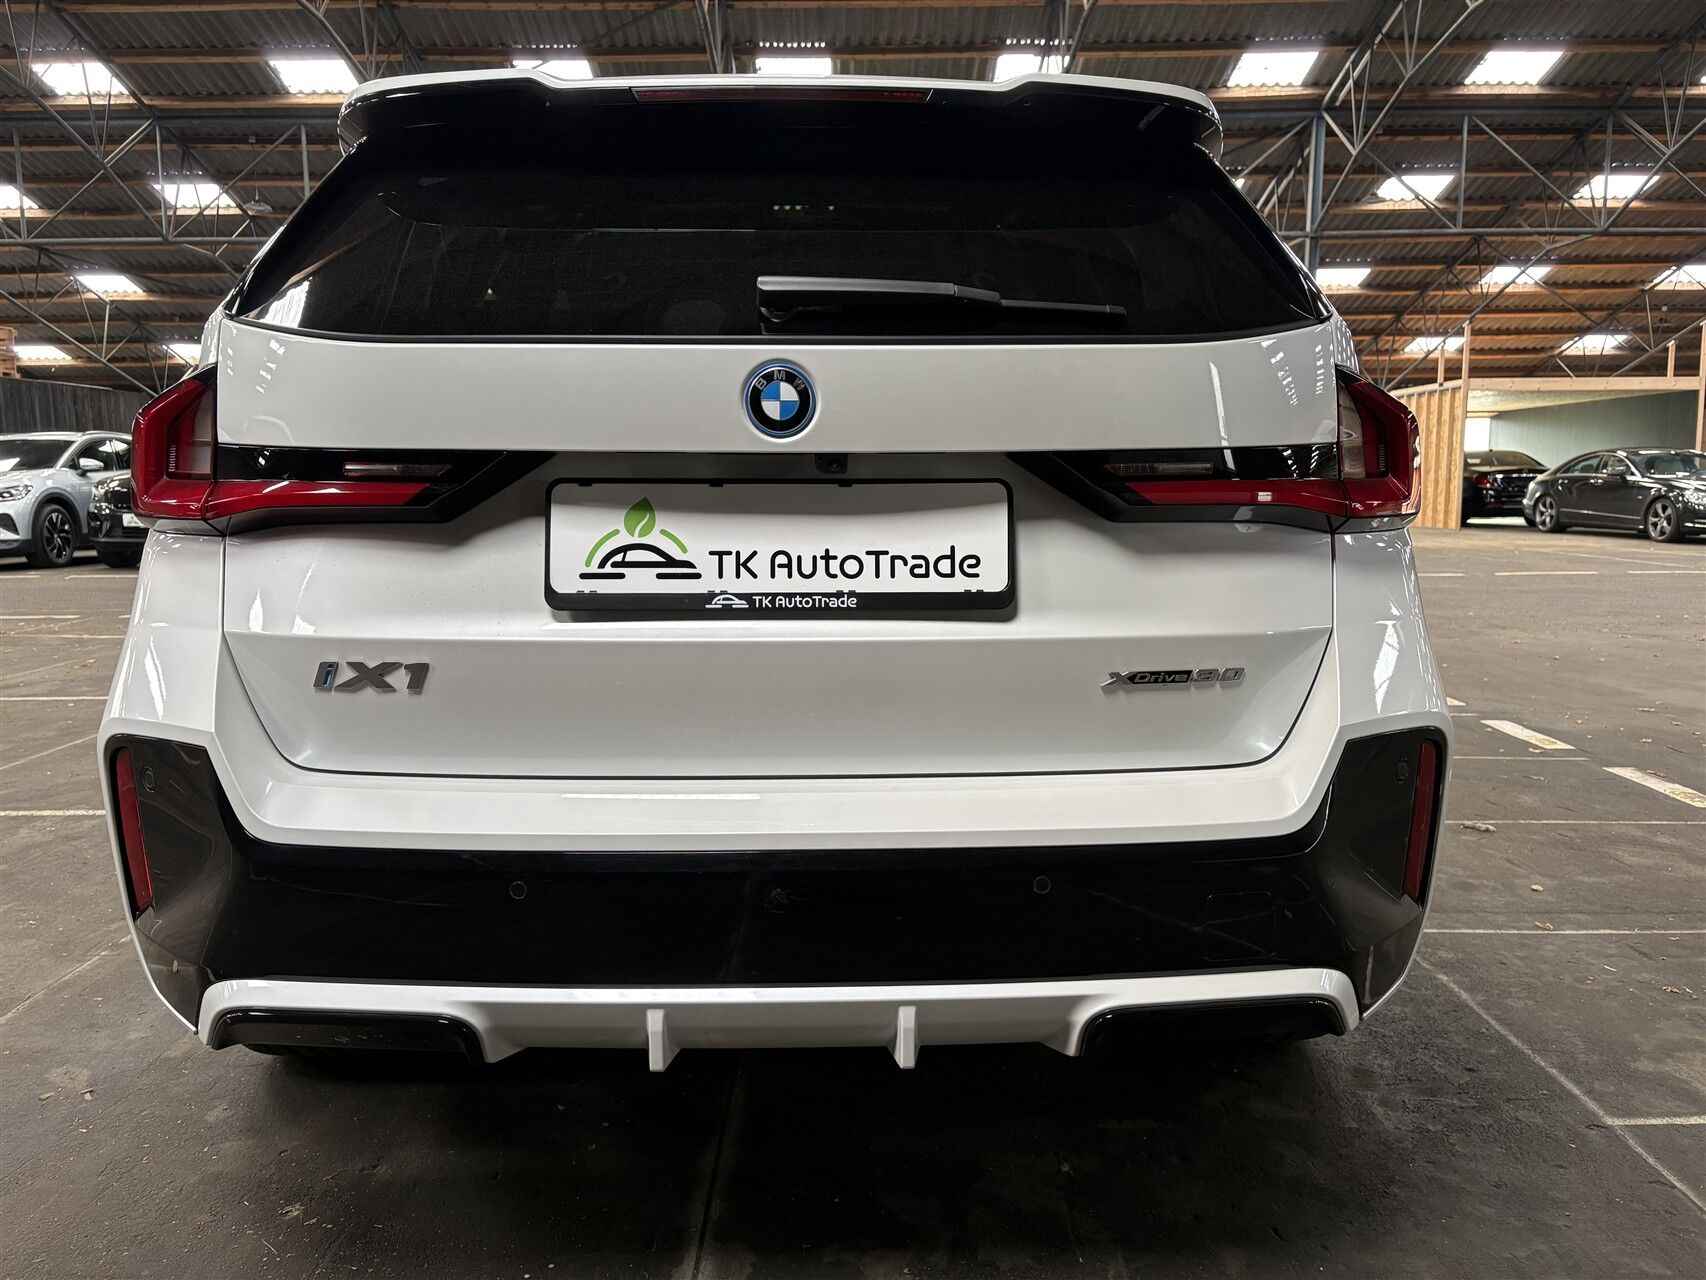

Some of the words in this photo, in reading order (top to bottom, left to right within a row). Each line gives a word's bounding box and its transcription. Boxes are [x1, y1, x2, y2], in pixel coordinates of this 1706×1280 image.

[754, 369, 806, 391] BMW
[708, 550, 758, 580] TK
[770, 544, 981, 580] AutoTrade
[752, 595, 772, 609] TK
[775, 593, 858, 609] AutoTrade
[312, 661, 430, 693] iX1
